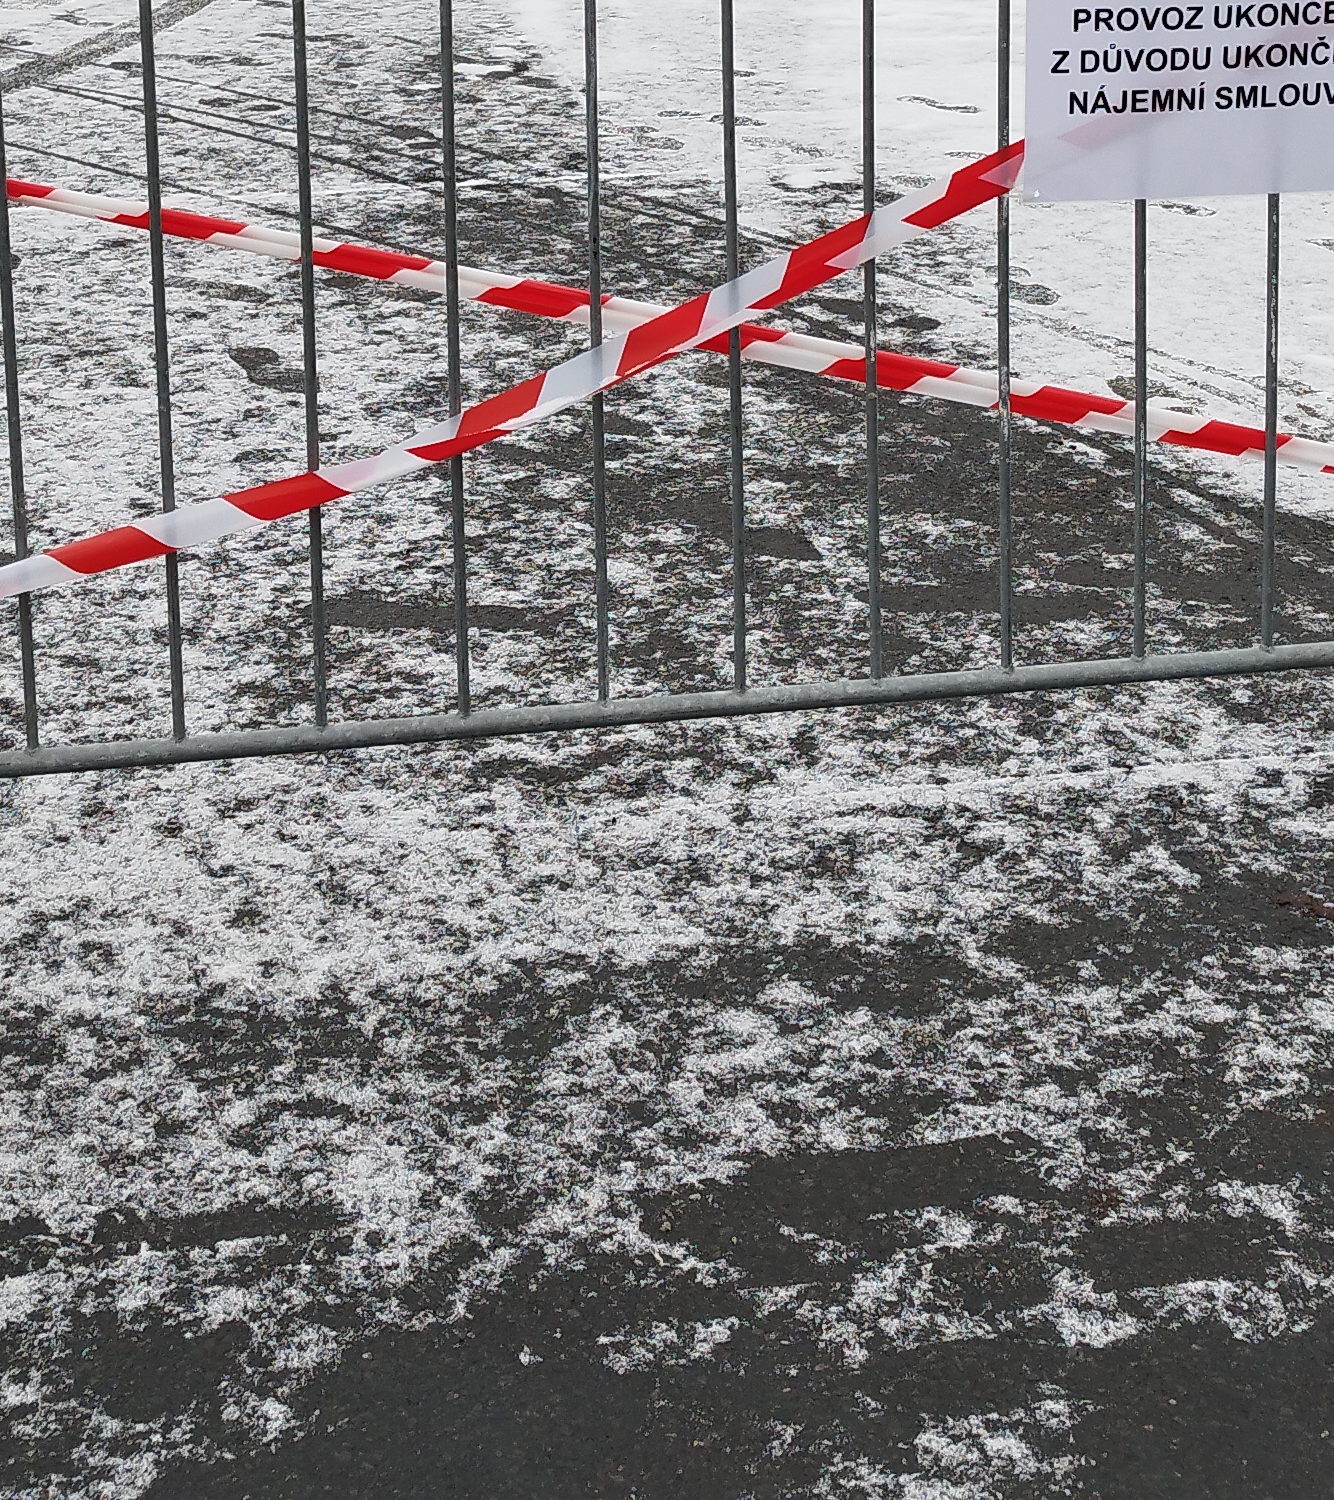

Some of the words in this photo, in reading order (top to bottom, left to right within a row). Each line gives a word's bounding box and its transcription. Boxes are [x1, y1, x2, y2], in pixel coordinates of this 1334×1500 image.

[1073, 6, 1203, 32] PROVOZ
[1050, 50, 1069, 74] Z
[1080, 43, 1211, 74] DŮVODU
[1069, 81, 1205, 115] NÁJEMNÍ
